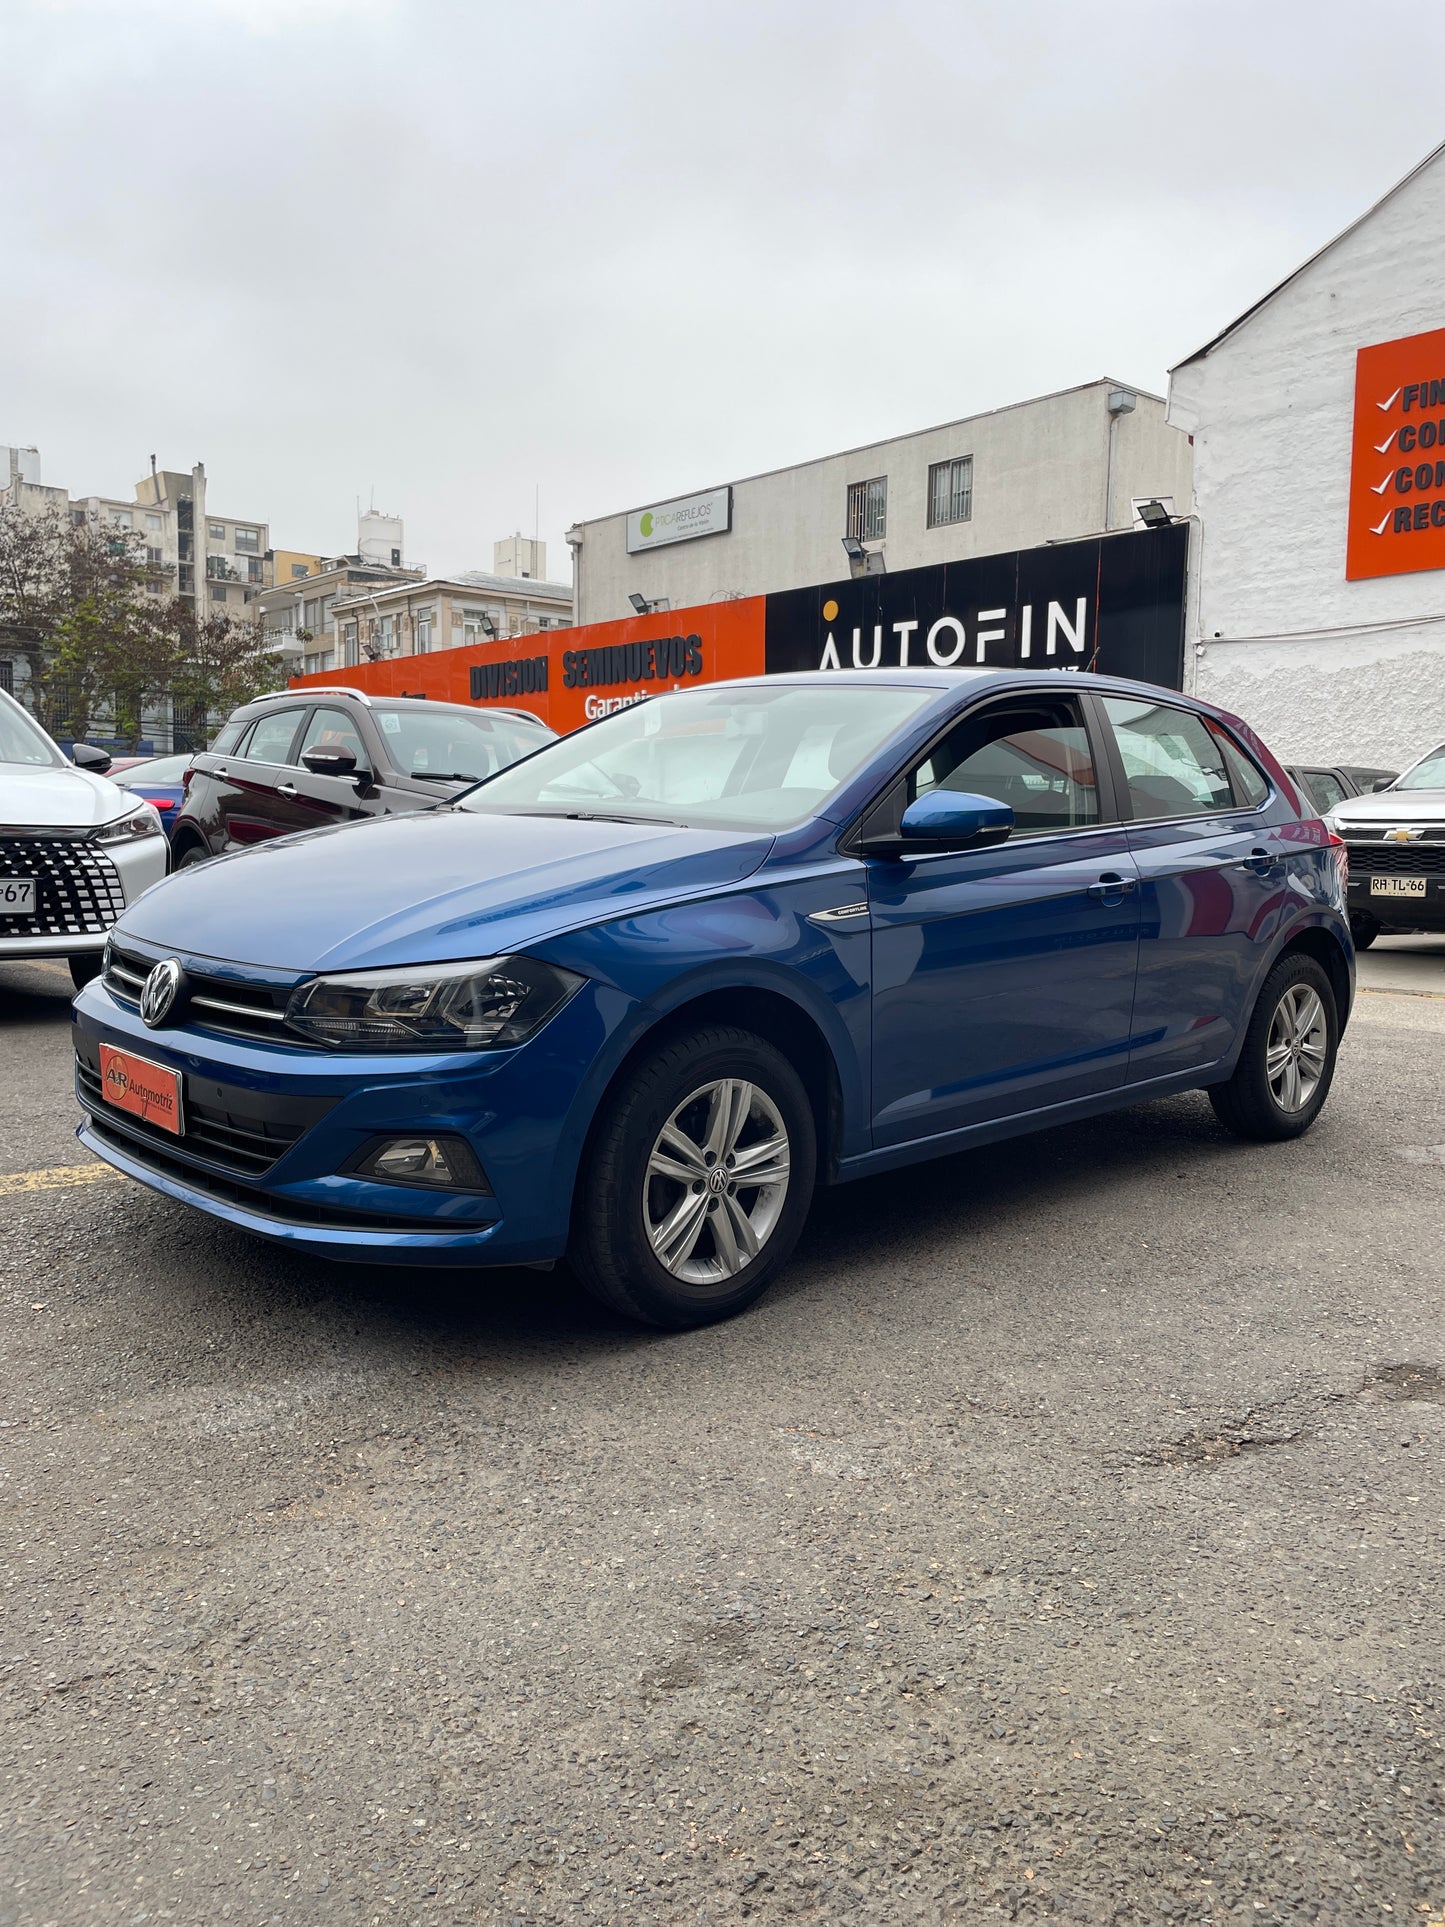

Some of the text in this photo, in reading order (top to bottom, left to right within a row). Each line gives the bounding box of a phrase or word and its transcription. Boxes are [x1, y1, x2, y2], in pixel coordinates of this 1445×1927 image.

[1394, 501, 1445, 533] REC
[820, 598, 1087, 670] AUTOFIN
[469, 634, 702, 700] DIVISION SEMINUEVOS
[585, 690, 654, 720] Garan
[129, 1079, 173, 1110] Automotriz
